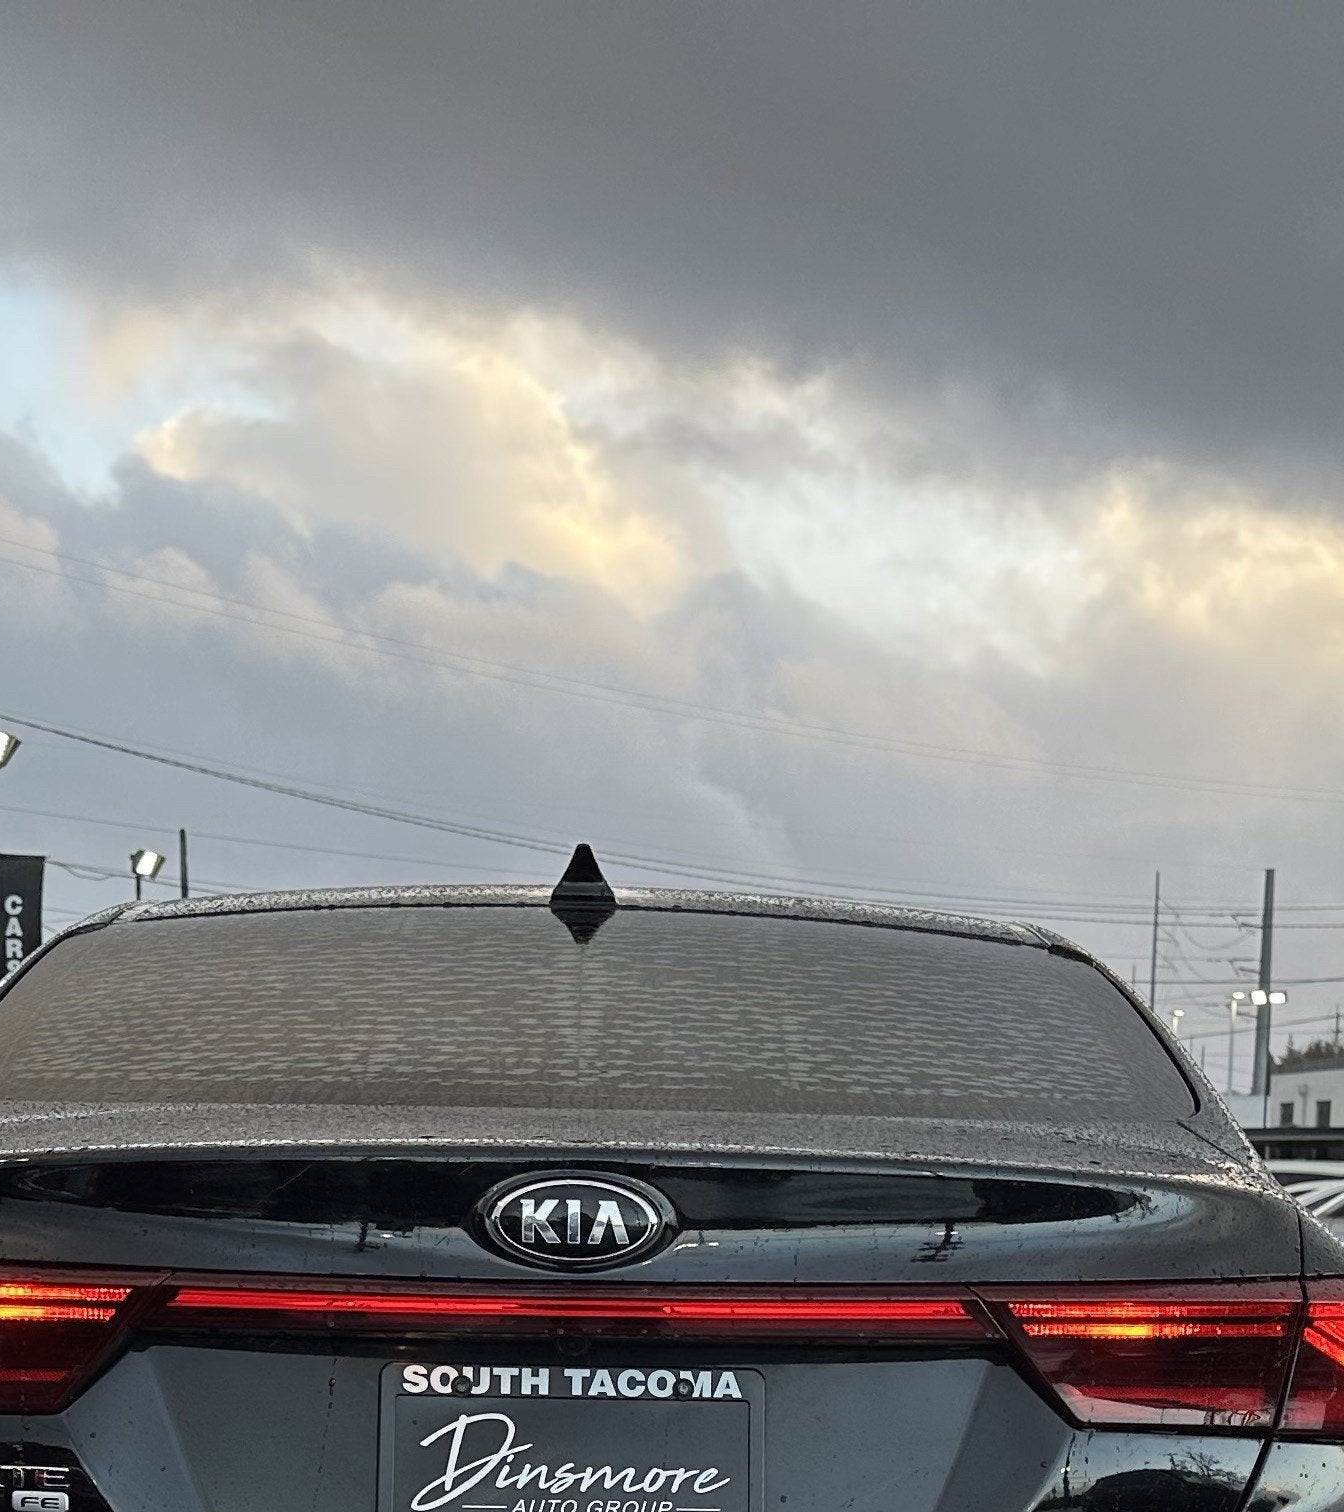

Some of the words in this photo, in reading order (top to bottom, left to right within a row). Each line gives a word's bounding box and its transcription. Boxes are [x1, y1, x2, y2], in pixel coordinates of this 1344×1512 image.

[520, 1199, 629, 1244] KIA
[402, 1364, 550, 1395] SOUTH
[564, 1368, 743, 1398] TACOMA
[410, 1412, 731, 1512] Dinsmore
[20, 1496, 60, 1510] FE
